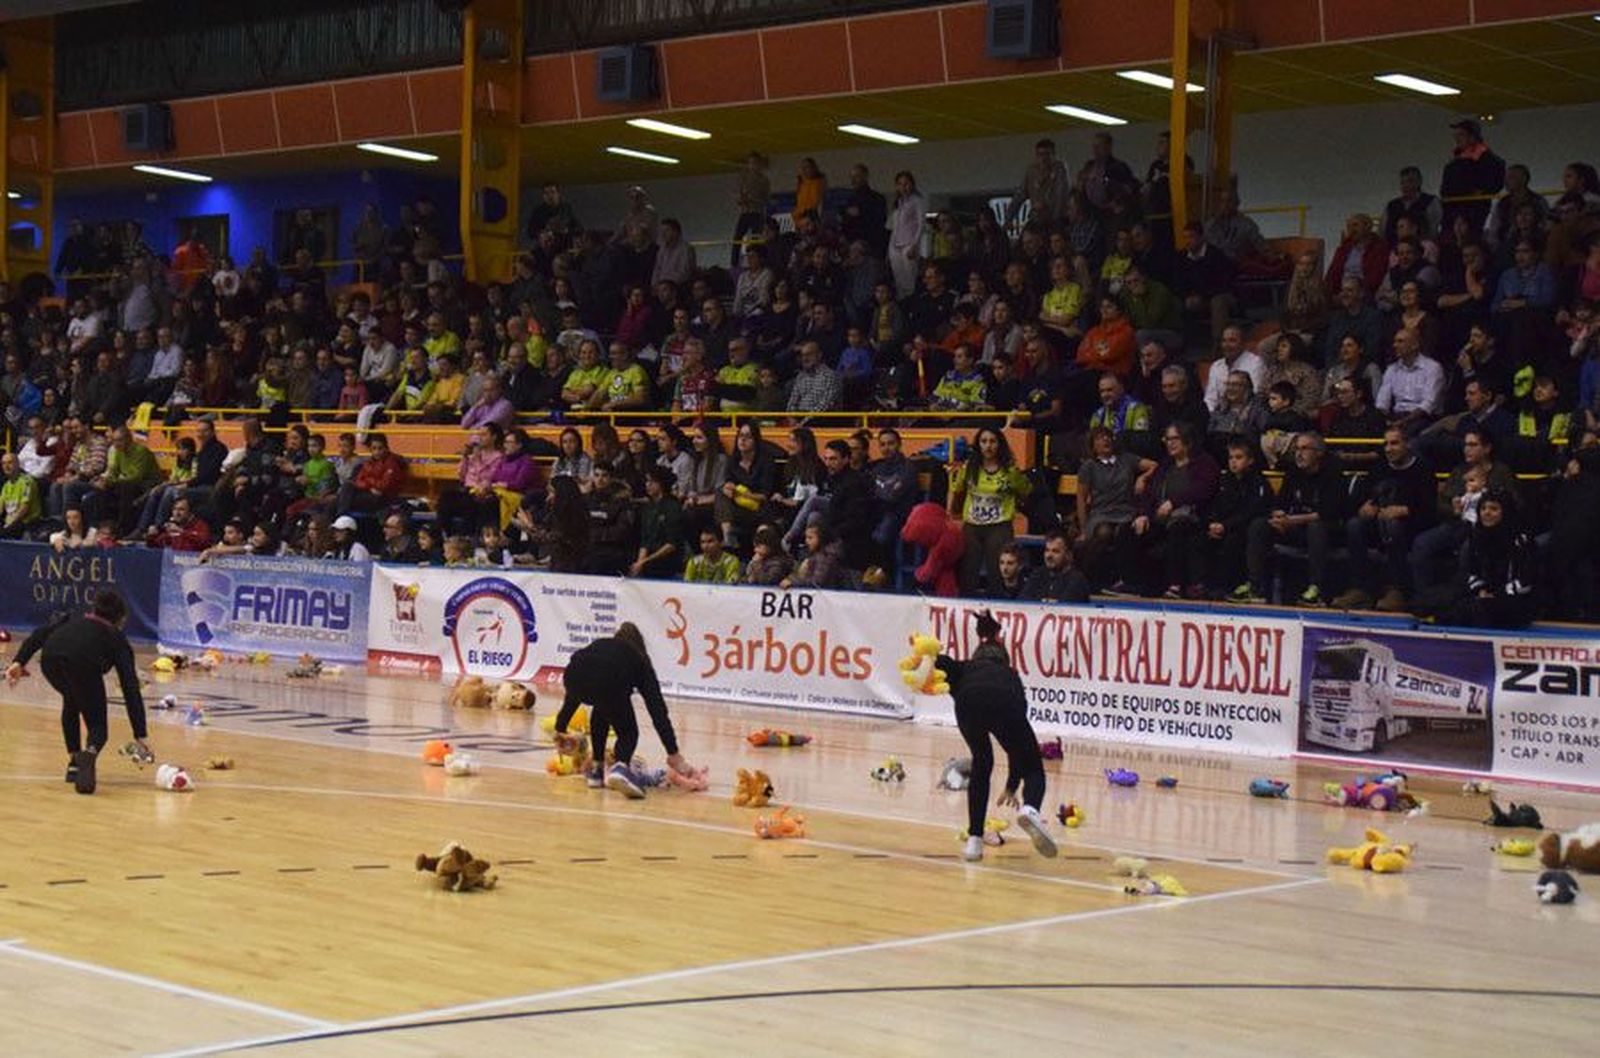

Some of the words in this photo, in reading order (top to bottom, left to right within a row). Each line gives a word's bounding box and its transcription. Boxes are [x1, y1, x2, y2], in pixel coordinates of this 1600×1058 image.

[29, 555, 116, 583] ANGEL
[232, 585, 351, 630] FRIMAY
[761, 592, 813, 620] BAR
[468, 650, 479, 664] EL
[481, 651, 513, 667] RIEGO
[701, 625, 873, 680] 3árboles
[1035, 613, 1172, 686] CENTRAL
[1179, 622, 1291, 697] DIESEL
[1501, 645, 1589, 662] CENTRO
[1030, 687, 1066, 704] TODO
[1070, 691, 1098, 707] TIPO
[1102, 694, 1118, 709] DE
[1123, 695, 1180, 714] EQUIPOS
[1184, 699, 1201, 716] DE
[1030, 707, 1060, 723] PARA
[1064, 711, 1100, 728] TODO
[1103, 714, 1134, 731] TIPO
[1138, 718, 1154, 733] DE
[1511, 711, 1557, 726] TODOS
[1562, 715, 1587, 729] LOS
[1511, 746, 1539, 760] CAP
[1555, 750, 1584, 764] ADR
